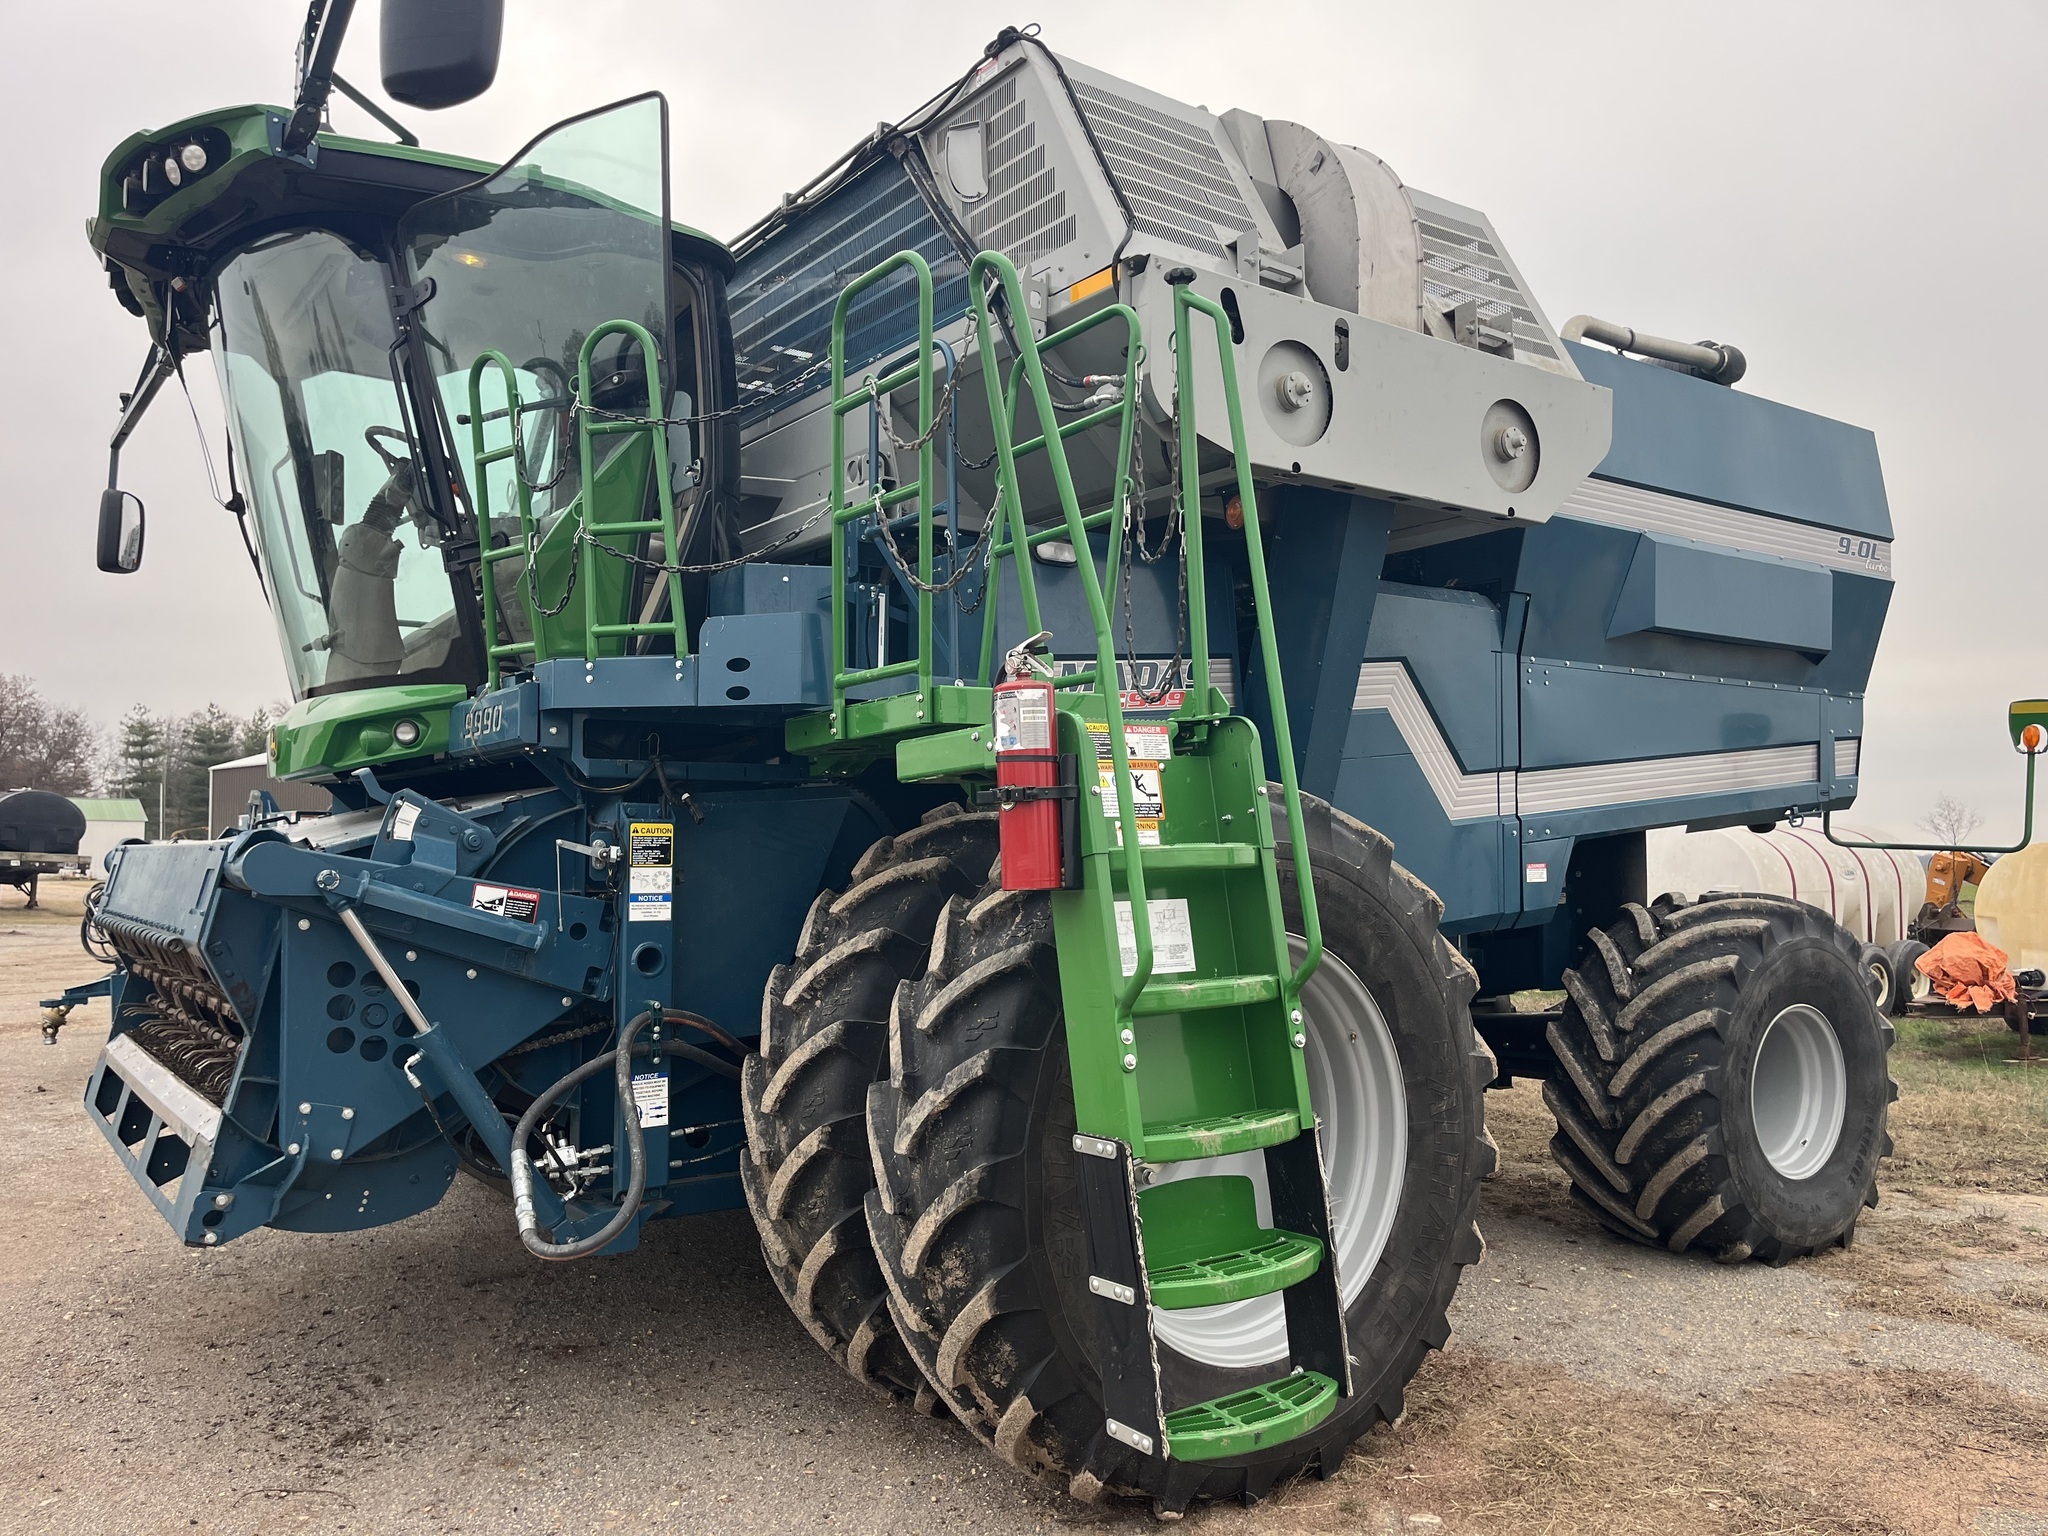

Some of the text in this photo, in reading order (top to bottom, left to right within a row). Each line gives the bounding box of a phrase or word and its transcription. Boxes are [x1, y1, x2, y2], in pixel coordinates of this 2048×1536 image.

[1837, 536, 1881, 561] 9.0L
[1865, 560, 1888, 573] turbo
[464, 704, 503, 740] 9990
[1133, 726, 1161, 734] DANGER
[640, 827, 673, 835] CAUTION
[513, 890, 538, 900] DANGER
[634, 1072, 659, 1081] NOTICE
